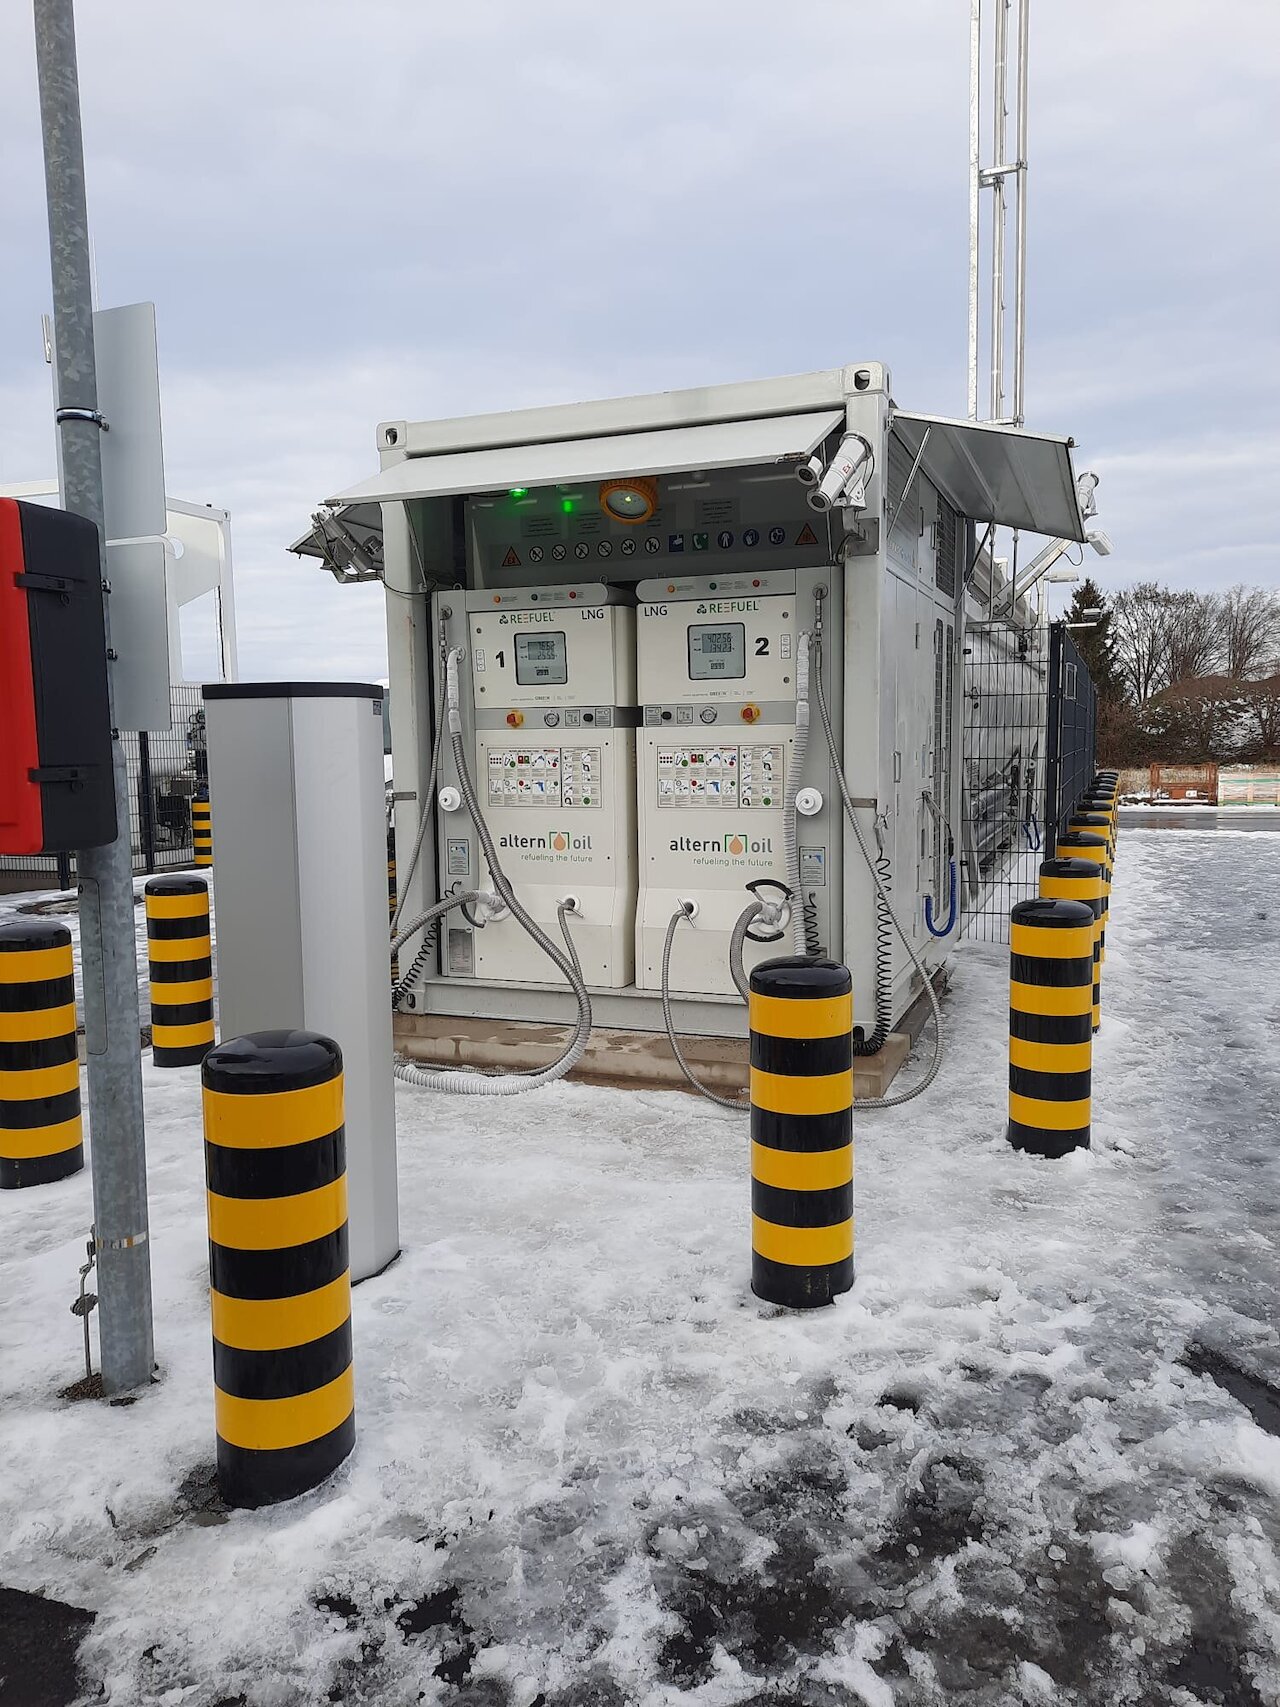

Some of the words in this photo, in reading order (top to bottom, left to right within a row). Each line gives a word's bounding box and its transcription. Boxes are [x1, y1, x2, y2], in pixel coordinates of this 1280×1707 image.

[581, 608, 604, 620] LNG
[644, 605, 668, 617] LNG
[754, 637, 770, 656] 2
[495, 651, 505, 668] 1
[500, 833, 546, 849] altern
[573, 835, 592, 850] oil
[669, 836, 721, 852] altern
[751, 839, 773, 853] oil
[521, 853, 554, 862] refueling
[570, 854, 593, 862] future
[693, 857, 730, 867] refueling
[731, 857, 745, 866] the
[748, 858, 773, 867] future
